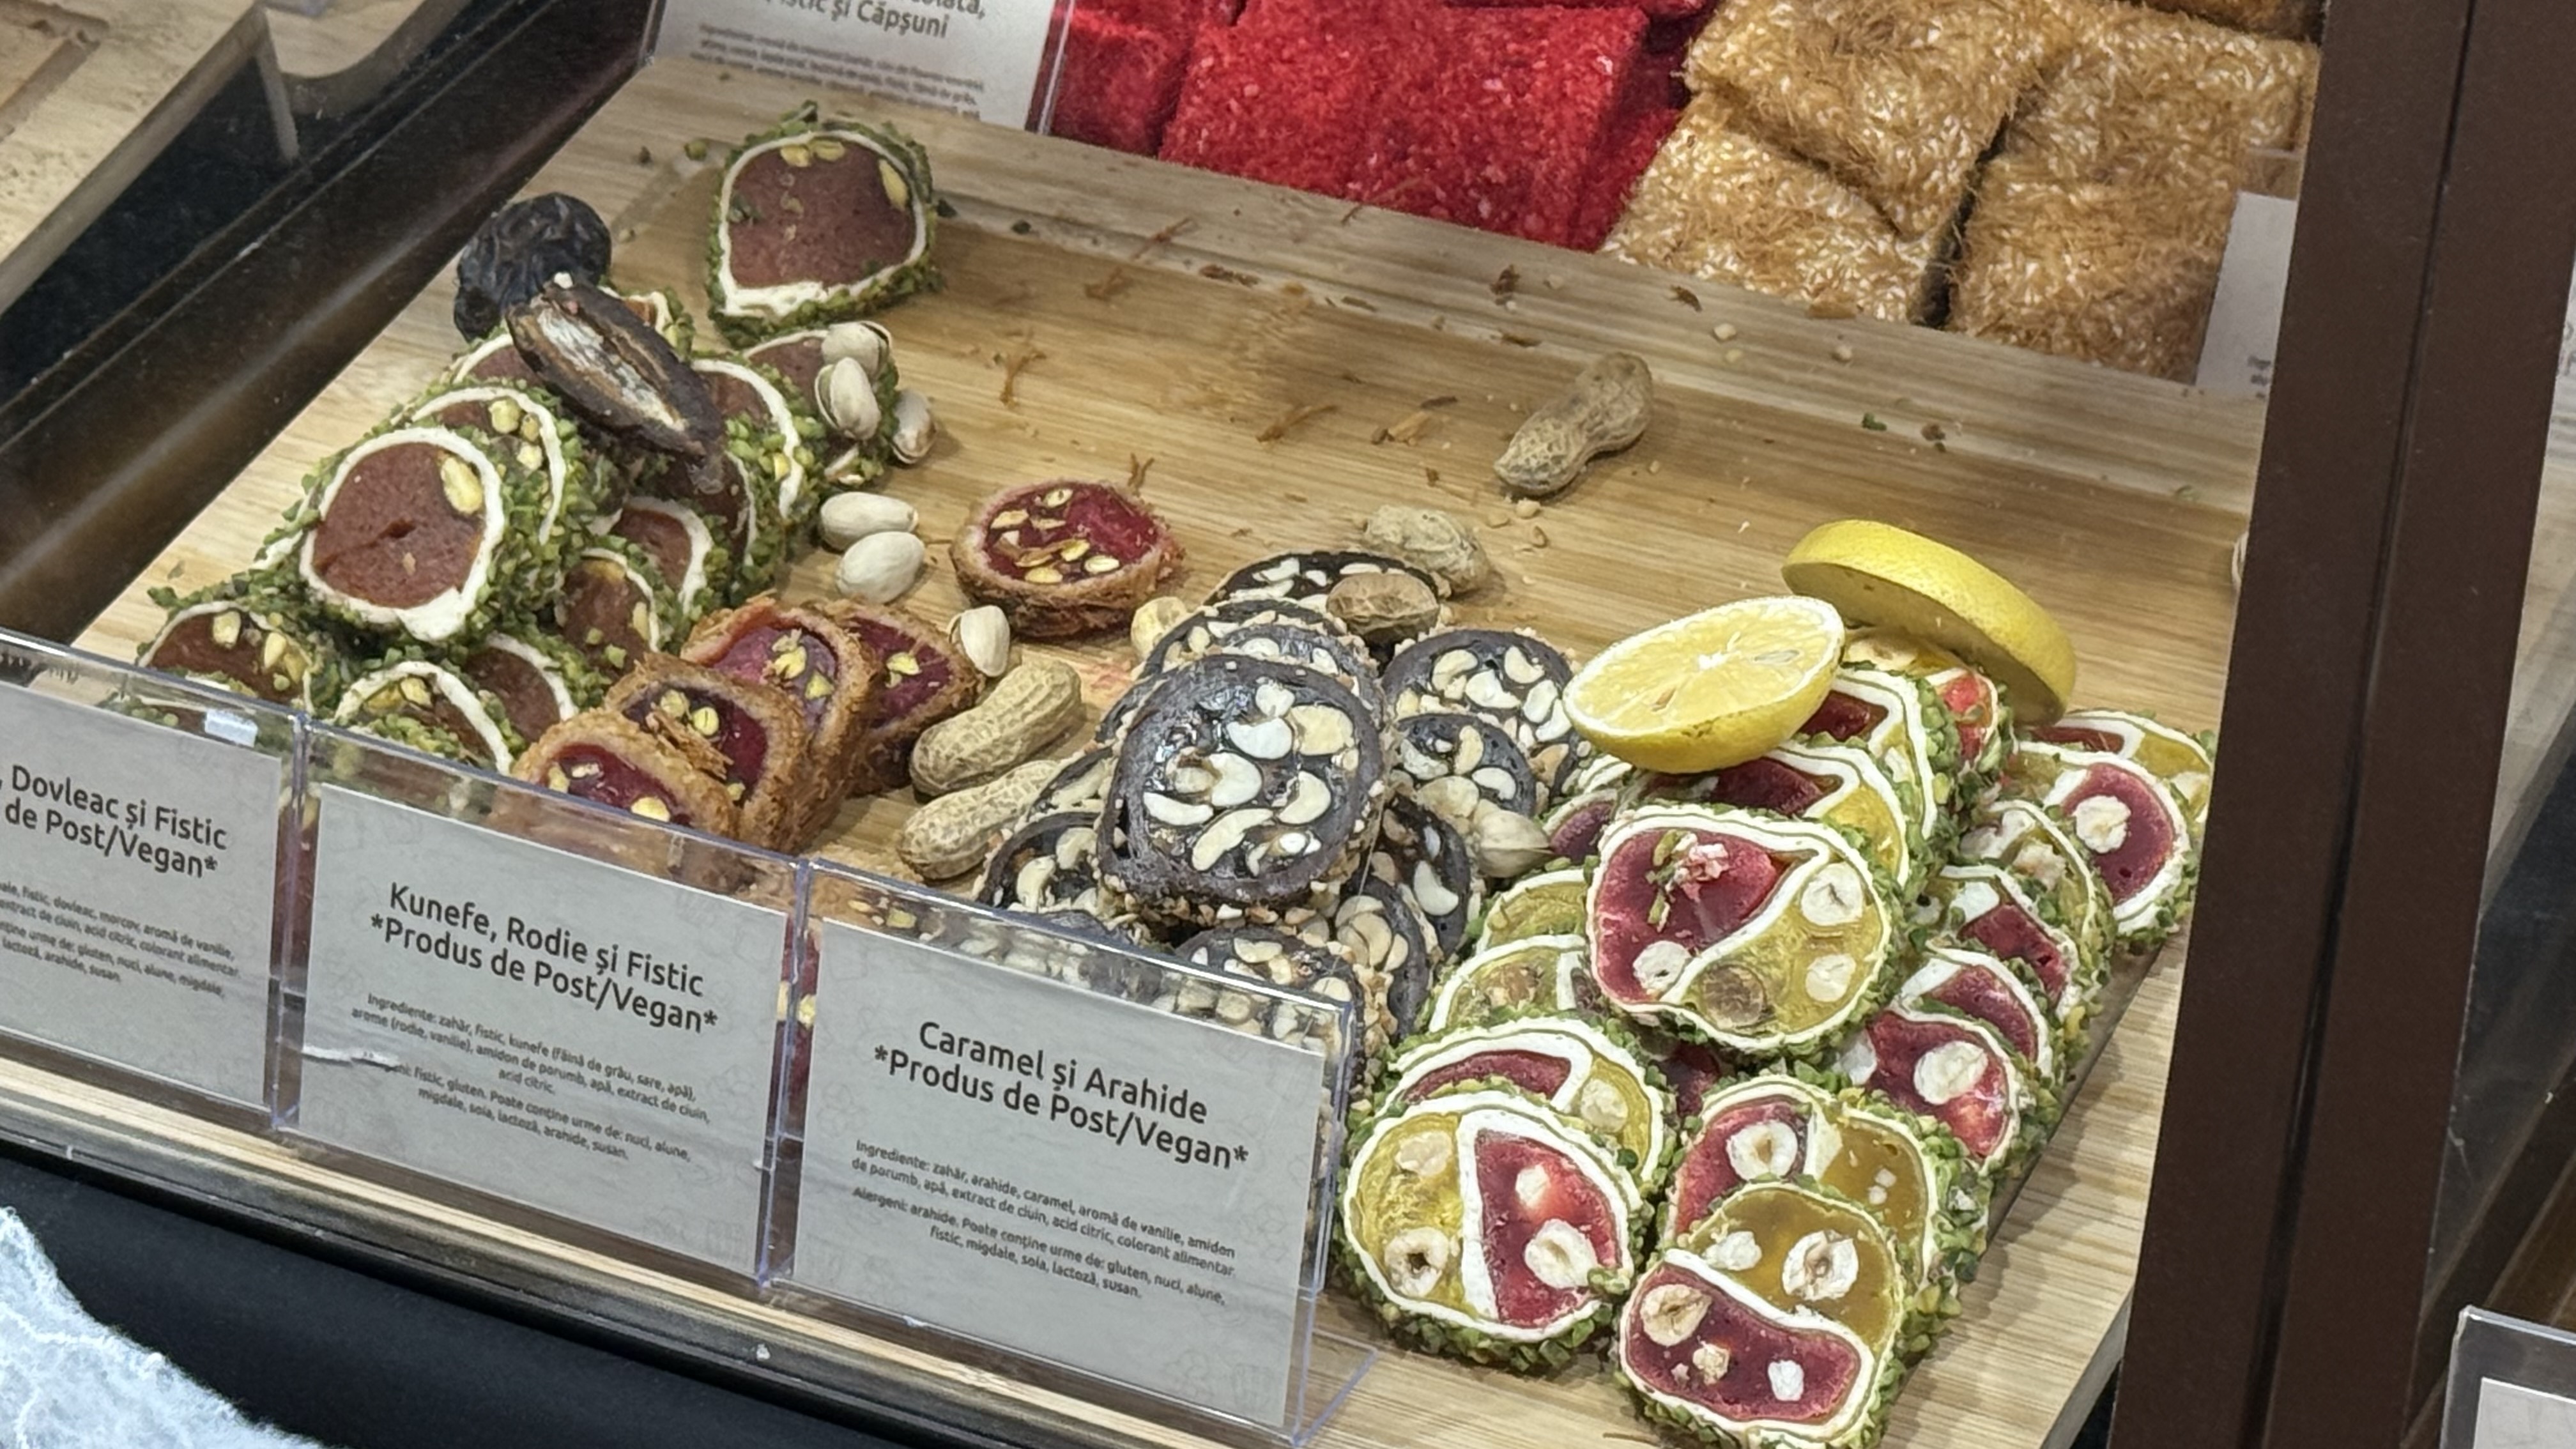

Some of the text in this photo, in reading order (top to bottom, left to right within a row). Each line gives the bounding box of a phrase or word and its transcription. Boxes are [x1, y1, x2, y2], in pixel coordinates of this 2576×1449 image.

[4, 796, 38, 830] de
[12, 764, 227, 850] Dovleac și Fistic
[390, 882, 703, 997] Kunefe, Rodie și Fistic
[490, 947, 526, 982] de
[521, 1056, 537, 1071] de
[660, 1097, 677, 1113] de
[586, 1057, 602, 1073] de
[919, 1021, 1208, 1124] Caramel și Arahide
[1003, 1080, 1041, 1116] de
[851, 1157, 868, 1173] de
[998, 1199, 1015, 1215] de
[1052, 1216, 1078, 1232] acid
[962, 1216, 999, 1239] Poate
[1049, 1245, 1083, 1264] urme
[1121, 1215, 1138, 1232] de
